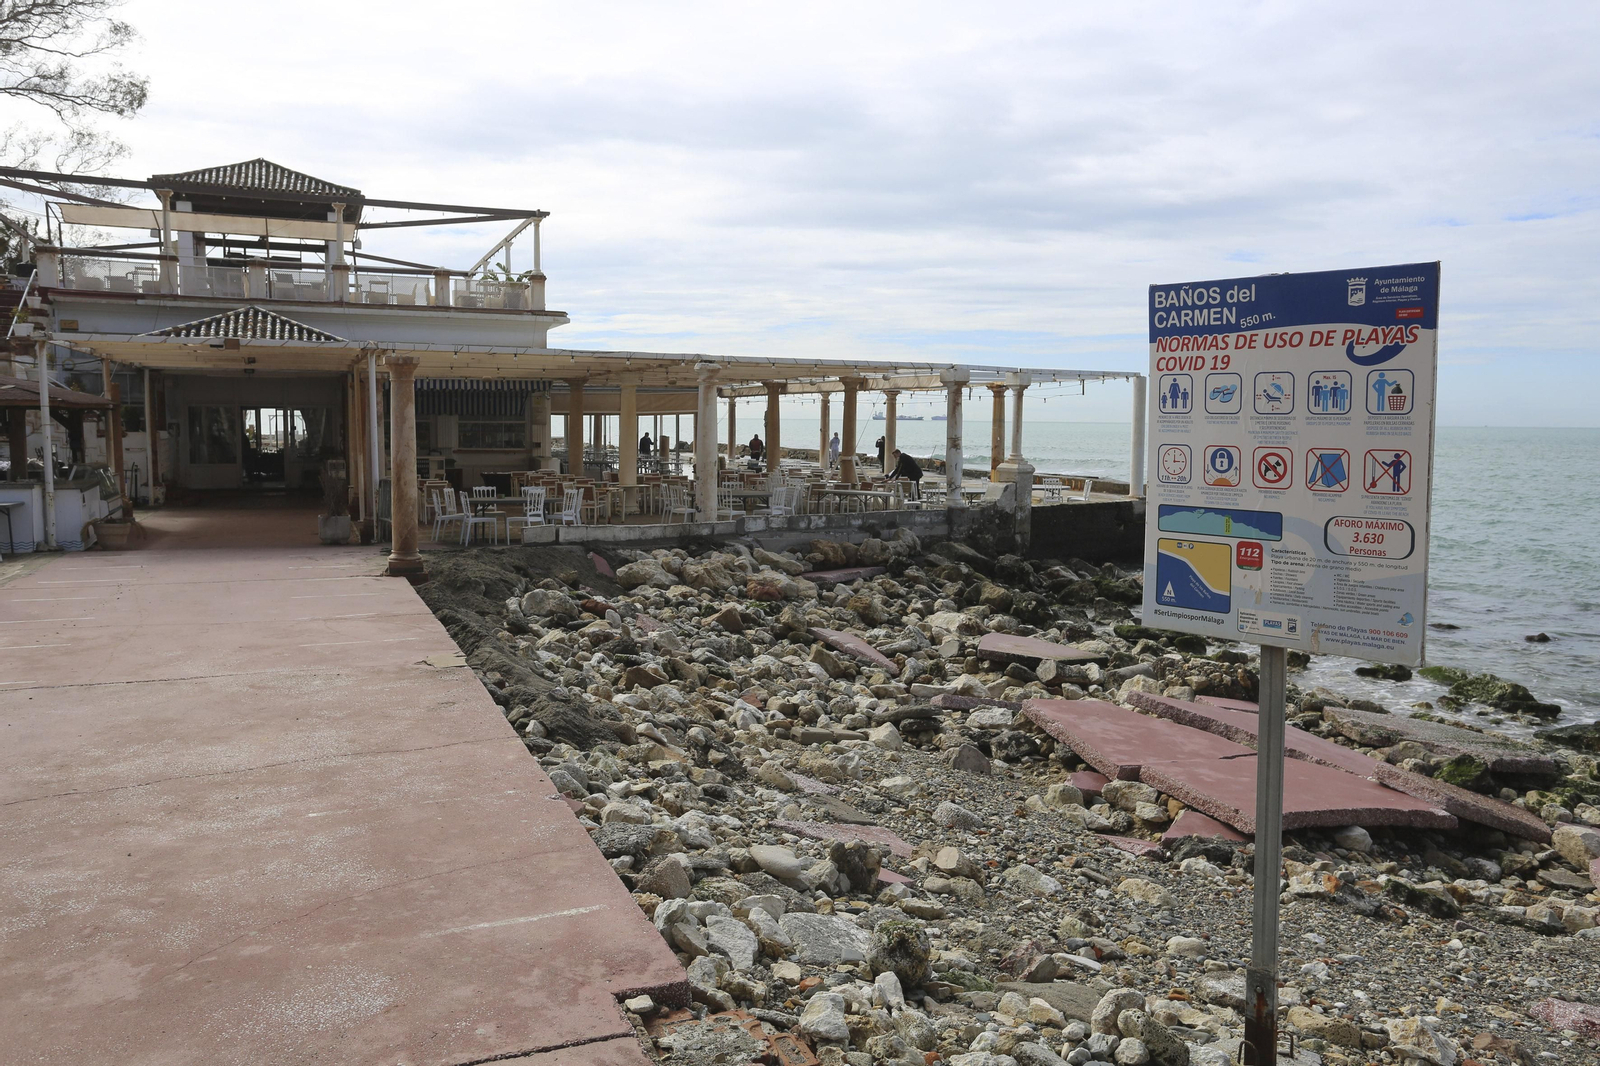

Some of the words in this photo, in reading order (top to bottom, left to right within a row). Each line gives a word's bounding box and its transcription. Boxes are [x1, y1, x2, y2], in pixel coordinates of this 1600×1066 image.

[1374, 276, 1425, 286] Ayuntamiento
[1154, 286, 1220, 308] BAÑOS
[1226, 284, 1256, 303] del
[1154, 306, 1236, 328] CARMEN
[1240, 314, 1260, 328] 550
[1262, 312, 1276, 322] m.
[1156, 334, 1230, 352] NORMAS
[1234, 334, 1258, 350] DE
[1264, 332, 1303, 348] USO
[1309, 330, 1337, 347] DE
[1342, 326, 1420, 346] PLAYAS
[1156, 356, 1205, 371] COVID
[1210, 355, 1230, 370] 19
[1334, 518, 1363, 529] AFORO
[1365, 520, 1404, 531] MÁXIMO
[1352, 532, 1384, 544] 3.630
[1240, 548, 1260, 557] 112
[1350, 546, 1387, 557] Personas
[1154, 609, 1224, 625] #SerLimpiosporMálaga
[1347, 626, 1367, 634] Playas
[1325, 637, 1395, 650] www.playas.malaga.eu
